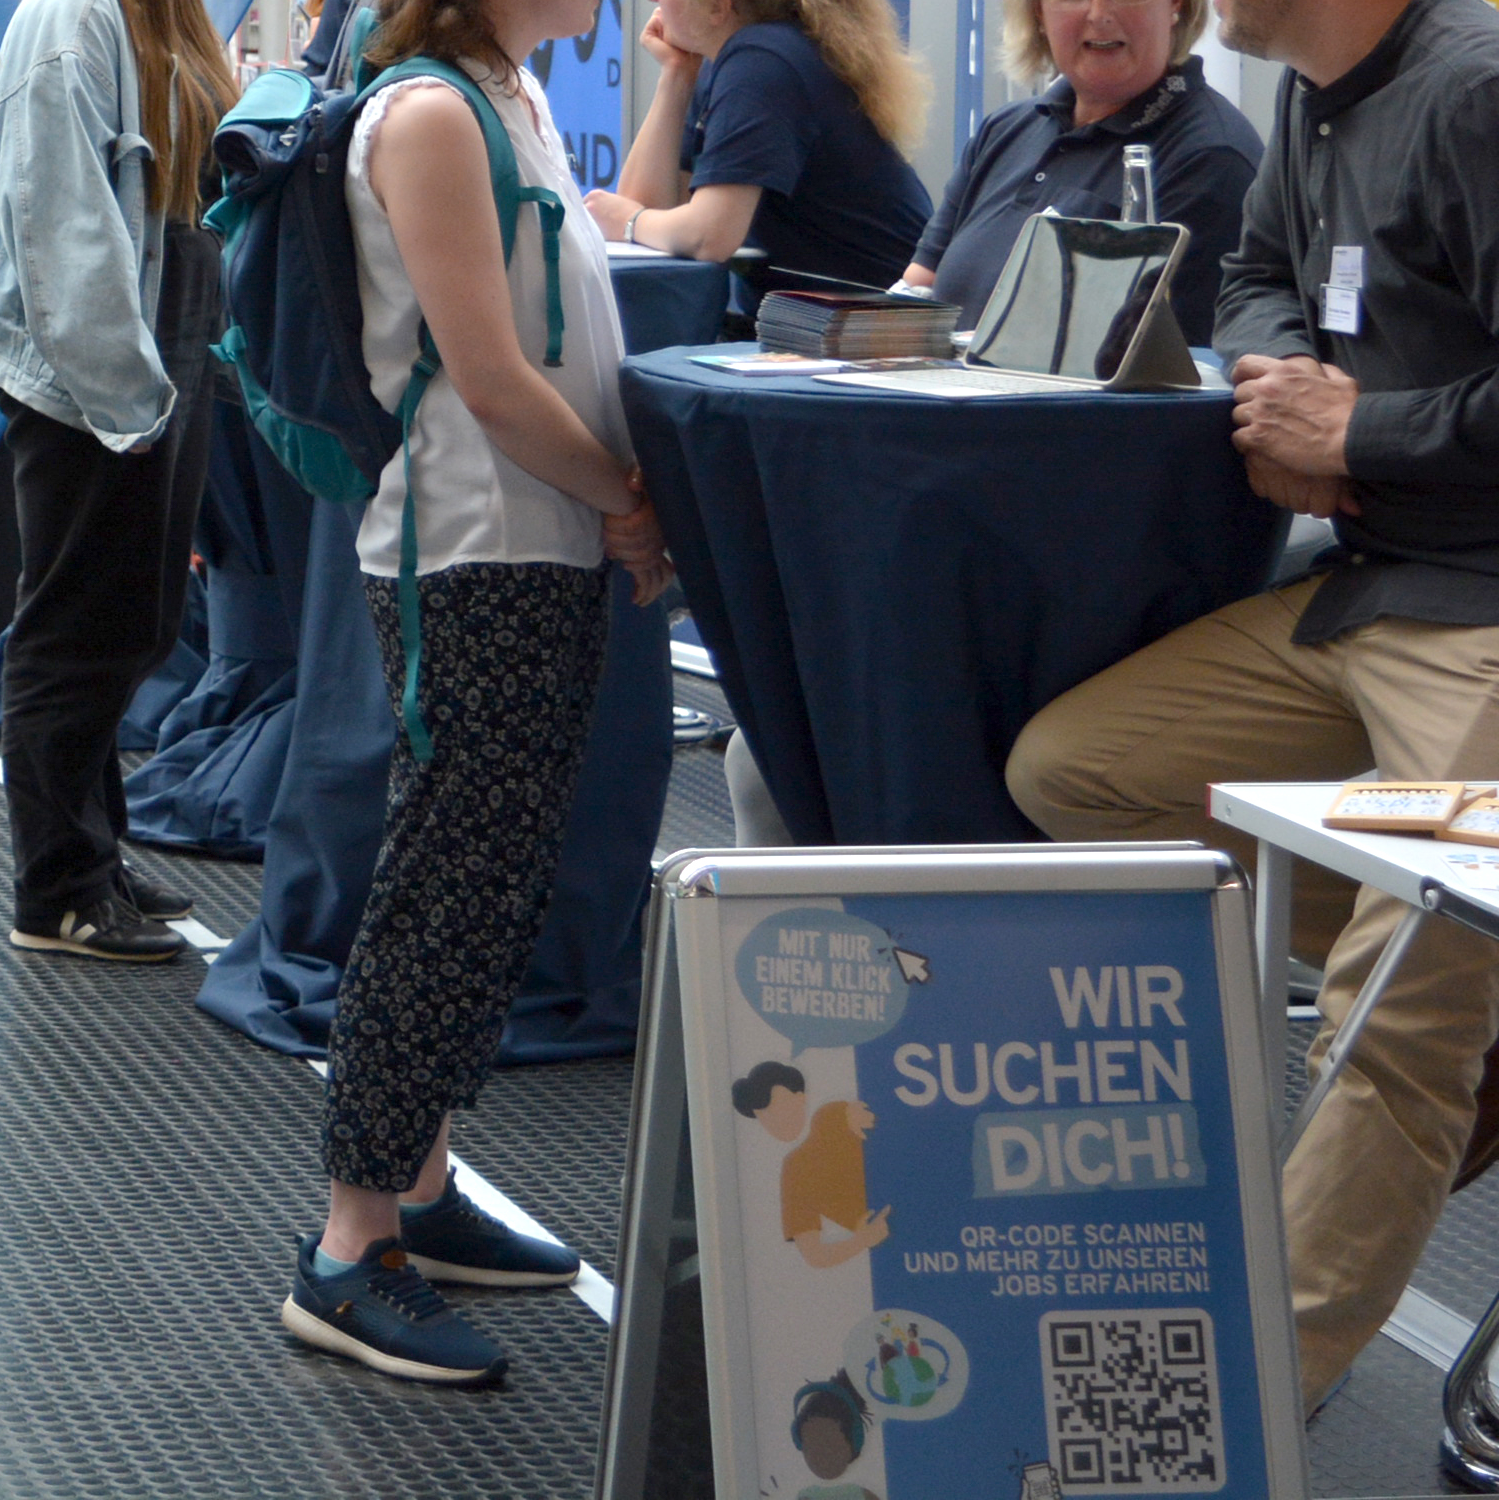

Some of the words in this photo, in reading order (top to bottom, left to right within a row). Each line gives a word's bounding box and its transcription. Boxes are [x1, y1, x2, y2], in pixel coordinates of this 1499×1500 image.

[778, 928, 822, 958] MIT
[828, 931, 872, 963] NUR
[755, 955, 824, 988] EINEM
[831, 963, 892, 994] KLICK
[761, 985, 886, 1022] BEWERBEN!
[1048, 965, 1187, 1030] WIR
[893, 1040, 1193, 1107] SUCHEN
[987, 1112, 1191, 1192] DICH!
[959, 1225, 1077, 1249] QR-CODE
[1083, 1222, 1207, 1246] SCANNEN
[904, 1251, 959, 1274] UND
[966, 1251, 1040, 1273] MEHR
[1046, 1249, 1081, 1271] ZU
[1087, 1247, 1209, 1271] UNSEREN
[990, 1274, 1058, 1297] JOBS
[1064, 1271, 1211, 1296] ERFAHREN!
